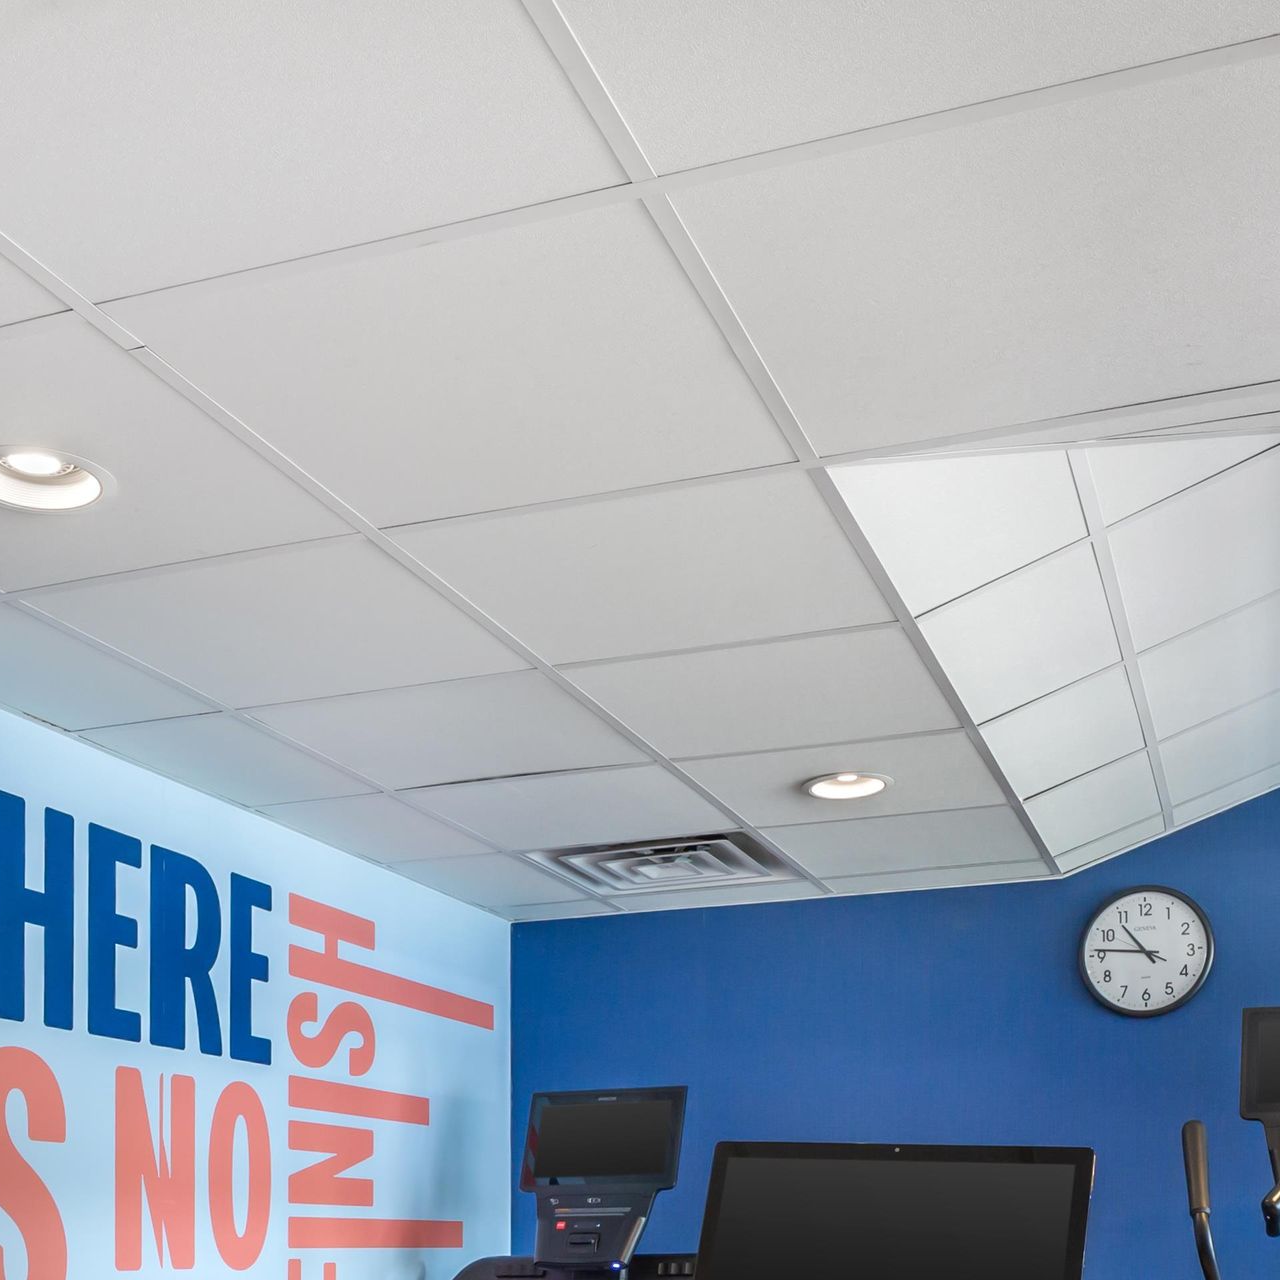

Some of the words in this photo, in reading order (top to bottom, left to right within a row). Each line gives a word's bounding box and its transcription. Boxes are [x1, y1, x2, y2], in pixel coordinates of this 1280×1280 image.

[1138, 903, 1152, 916] 12
[1166, 906, 1171, 920] 1
[1118, 910, 1128, 924] 11
[1101, 929, 1115, 942] 10
[1181, 922, 1190, 936] 2
[1097, 950, 1106, 963] 9
[1186, 943, 1195, 957] 3
[1103, 969, 1112, 983] 8
[1179, 964, 1189, 977] 4
[1120, 985, 1128, 998] 7
[1141, 988, 1151, 1001] 6
[1164, 982, 1174, 996] 5
[114, 1065, 272, 1272] NO
